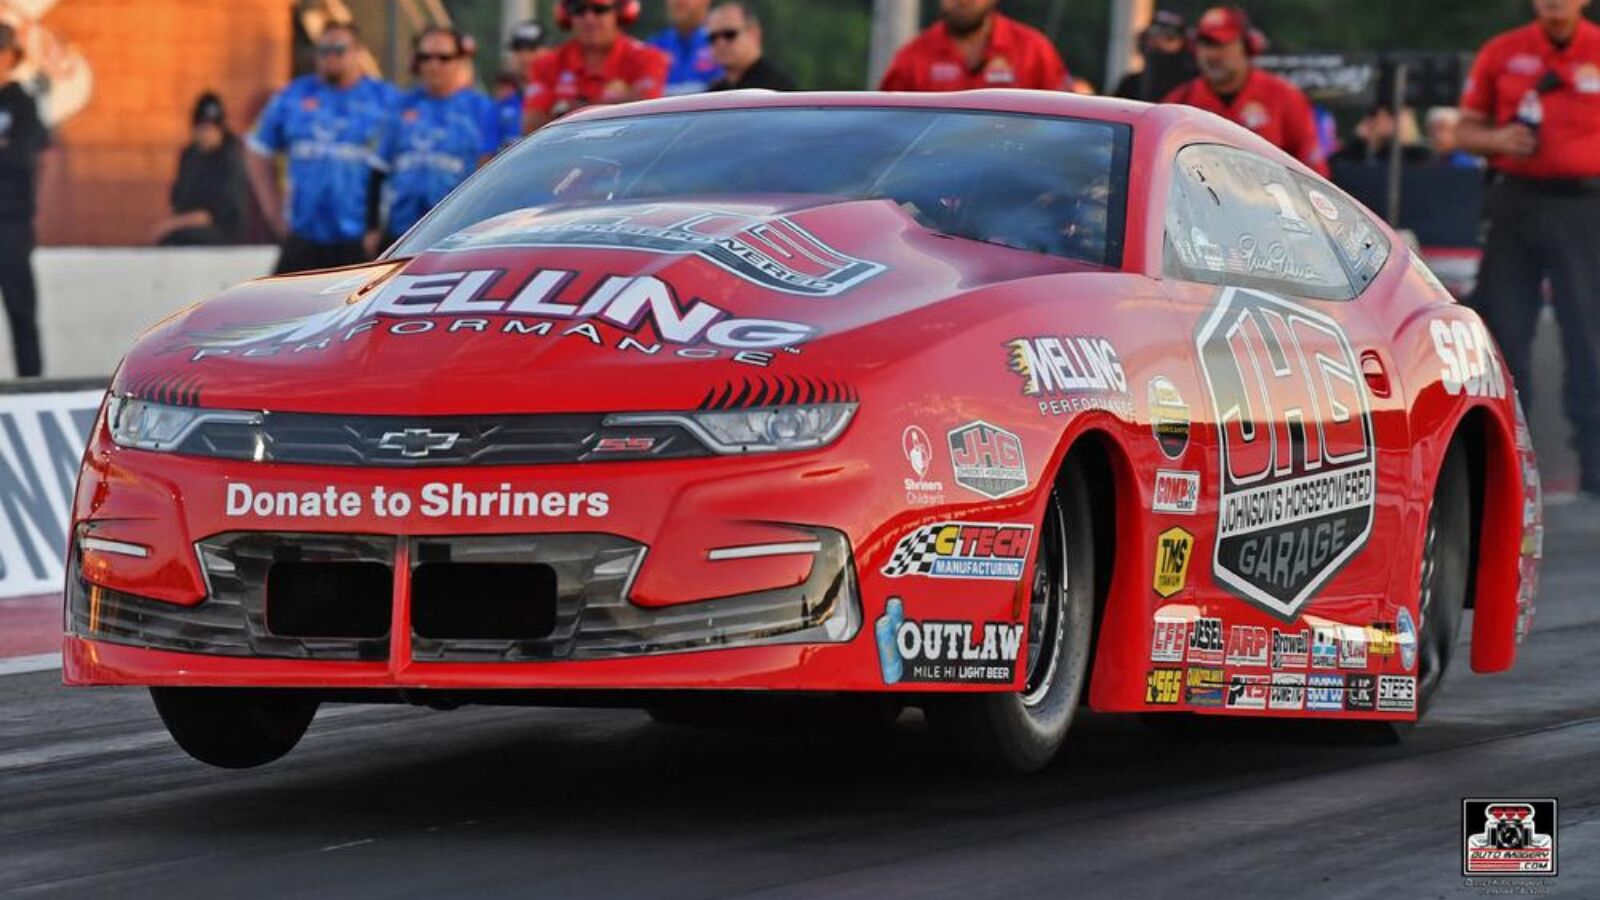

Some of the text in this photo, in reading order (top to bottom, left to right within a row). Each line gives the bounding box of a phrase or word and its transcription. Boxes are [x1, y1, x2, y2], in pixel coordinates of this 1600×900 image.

[240, 267, 816, 348] MELLING
[190, 317, 774, 368] PERFORMANCE
[1021, 336, 1128, 394] MELLING
[1222, 307, 1367, 485] JHG
[954, 427, 1020, 468] JHG
[226, 483, 609, 517] Donate to Shriners
[1221, 469, 1371, 533] JOHNSON'S HORSEPOWERED
[935, 560, 1019, 576] MANUFACTURING
[1162, 539, 1187, 573] TMS
[1239, 517, 1346, 589] GARAGE
[897, 621, 1024, 660] OUTLAW
[1190, 619, 1223, 650] JESEL
[1228, 628, 1266, 656] ARP
[914, 665, 1009, 679] MILE HI LIGHT BEER
